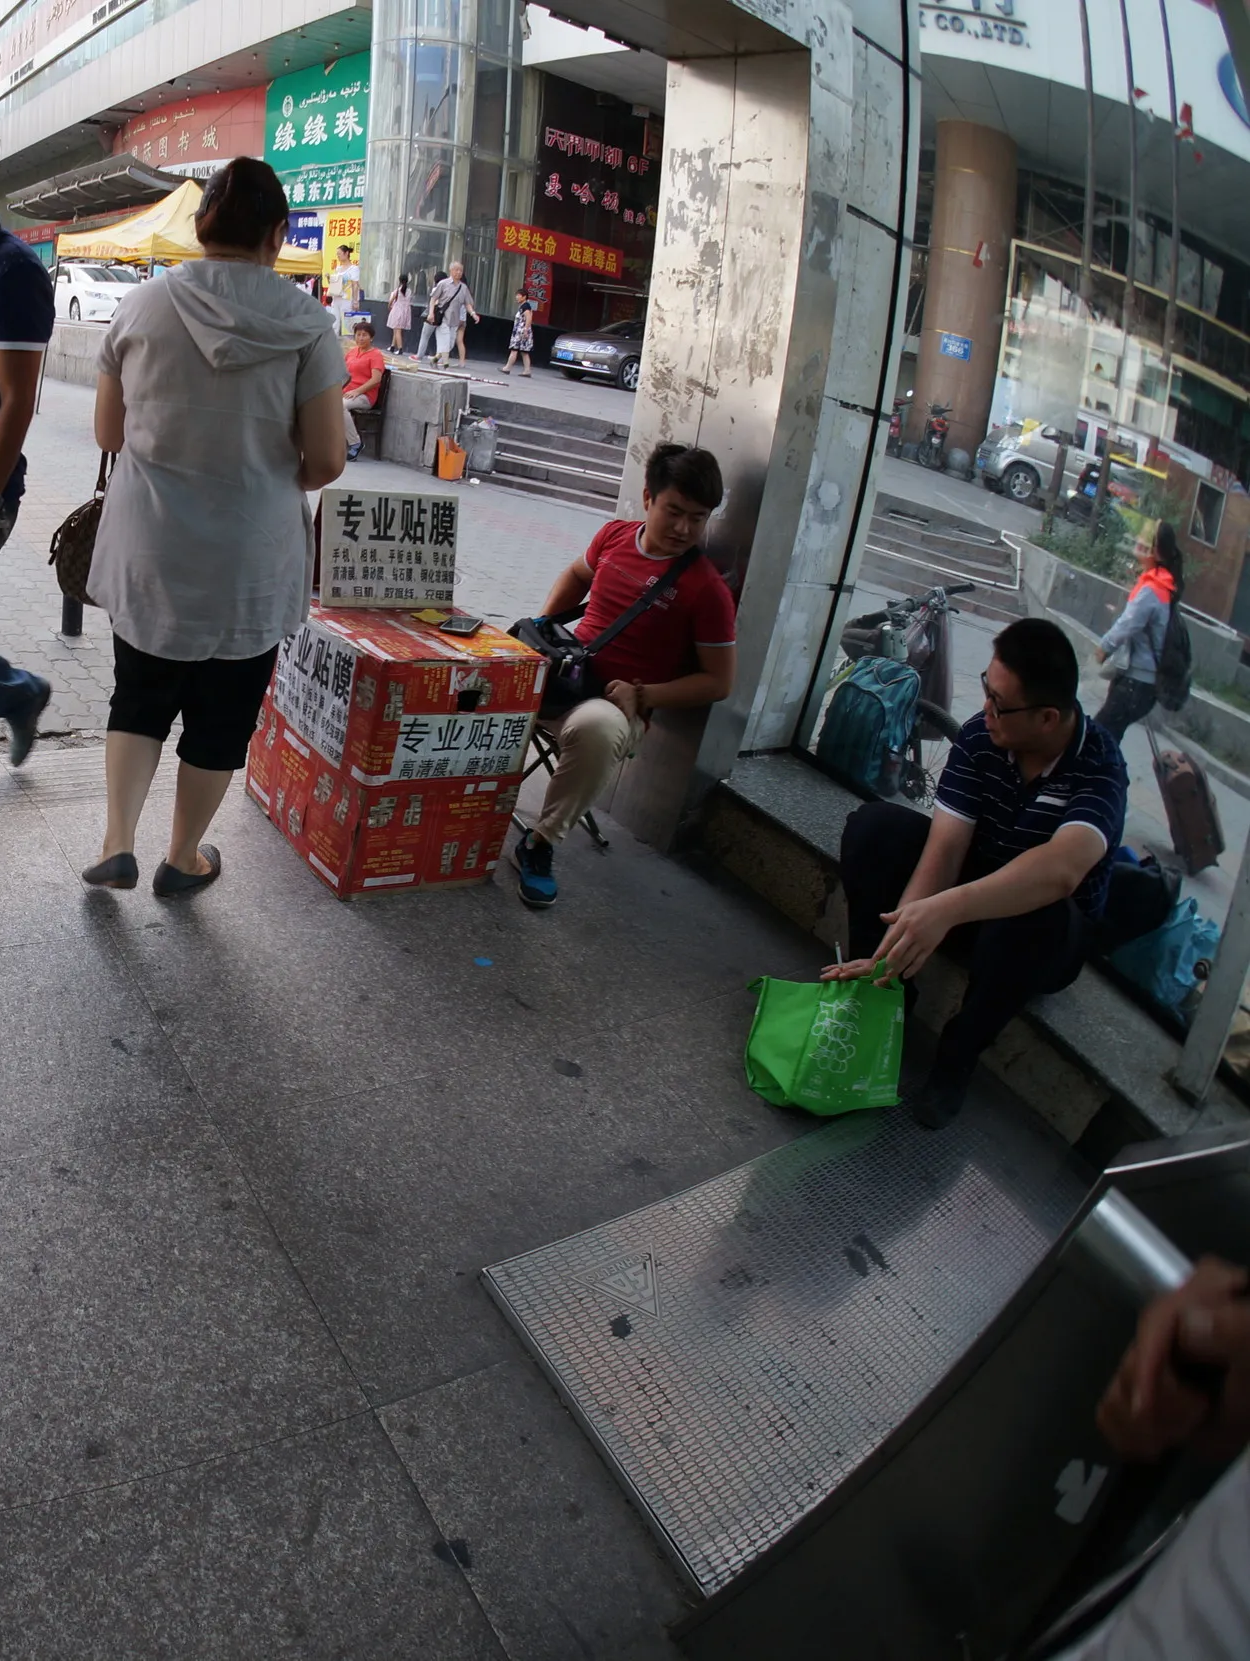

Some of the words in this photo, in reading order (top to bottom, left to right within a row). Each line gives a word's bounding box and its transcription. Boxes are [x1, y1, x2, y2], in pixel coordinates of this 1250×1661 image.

[627, 156, 650, 176] 6F
[544, 173, 619, 214] 曼哈顿
[504, 225, 557, 257] 珍爱生命
[569, 242, 617, 273] 远离毒品
[336, 494, 455, 548] 专业贴膜
[399, 717, 528, 754] 专业贴膜
